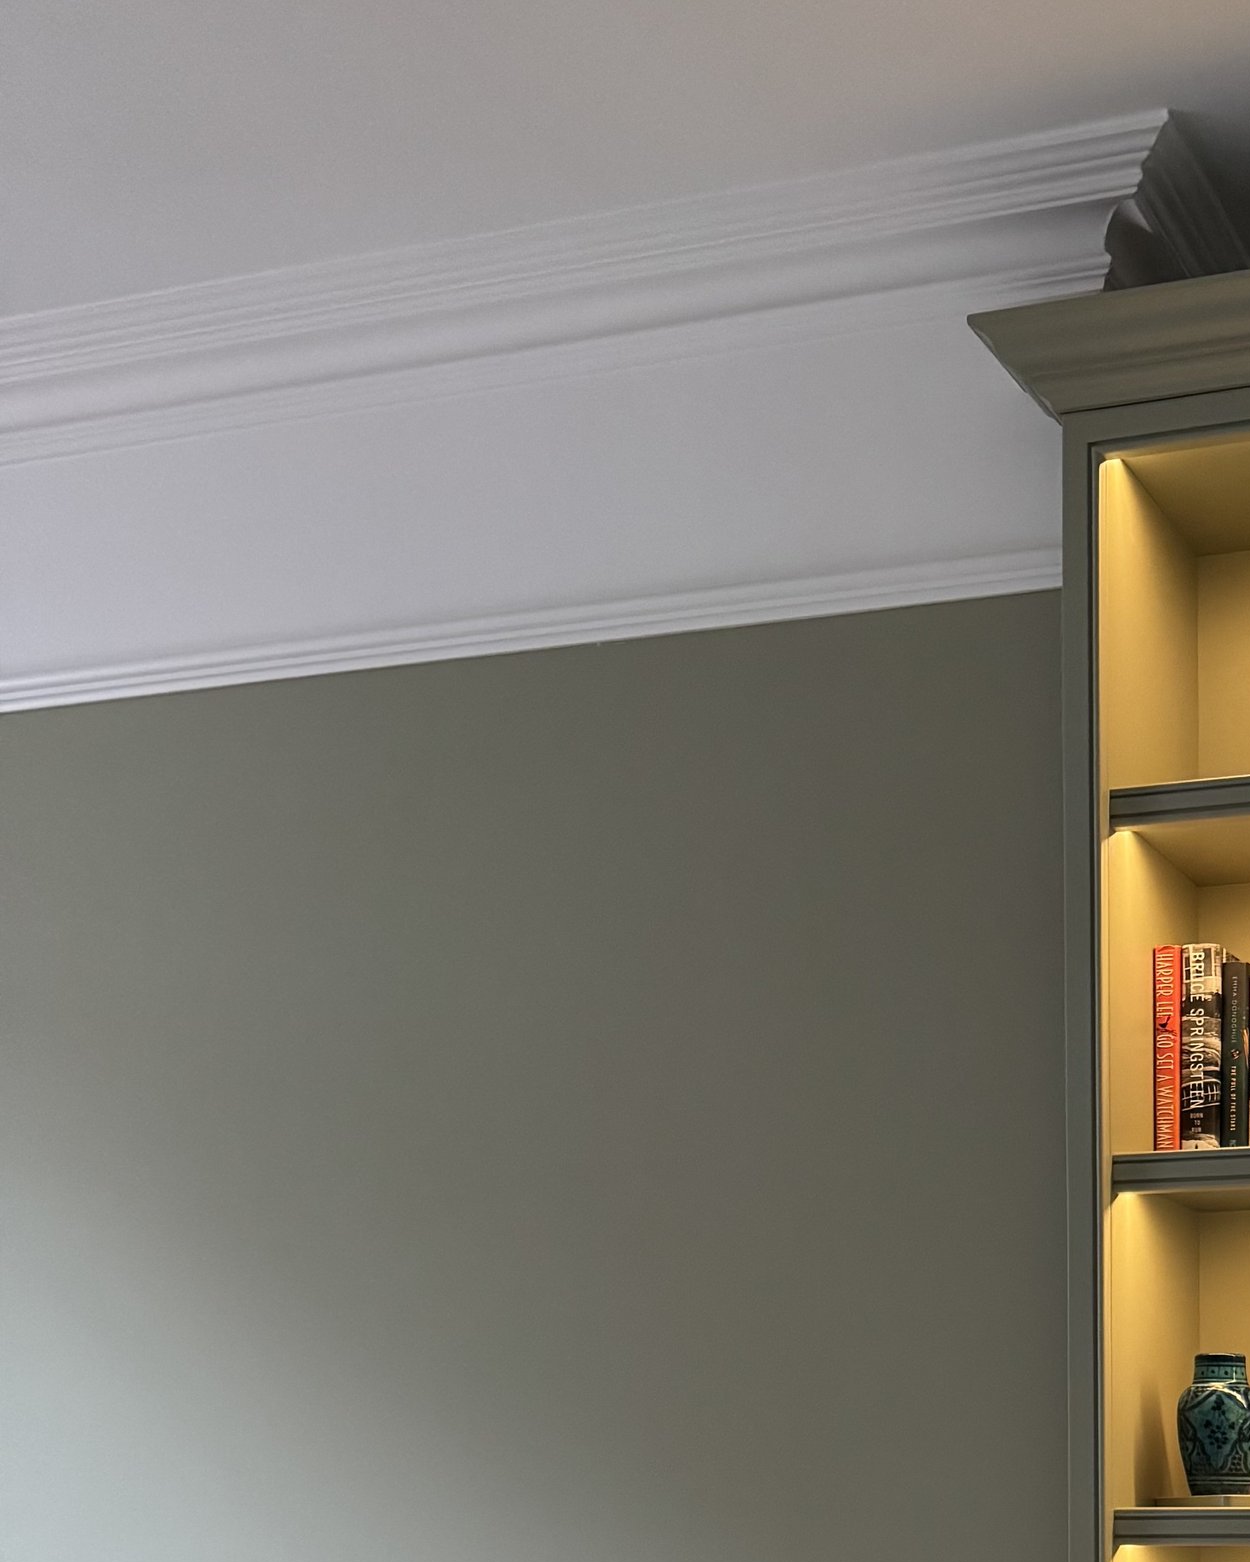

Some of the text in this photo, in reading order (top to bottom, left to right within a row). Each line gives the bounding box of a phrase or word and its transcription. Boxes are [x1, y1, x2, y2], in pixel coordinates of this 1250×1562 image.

[1156, 953, 1174, 1018] HARPER LEE
[1156, 1034, 1174, 1048] GO
[1156, 1053, 1174, 1069] SET
[1190, 952, 1205, 1109] BRUCE SPRINGSTEEN
[1156, 1085, 1174, 1148] WATCHMAN
